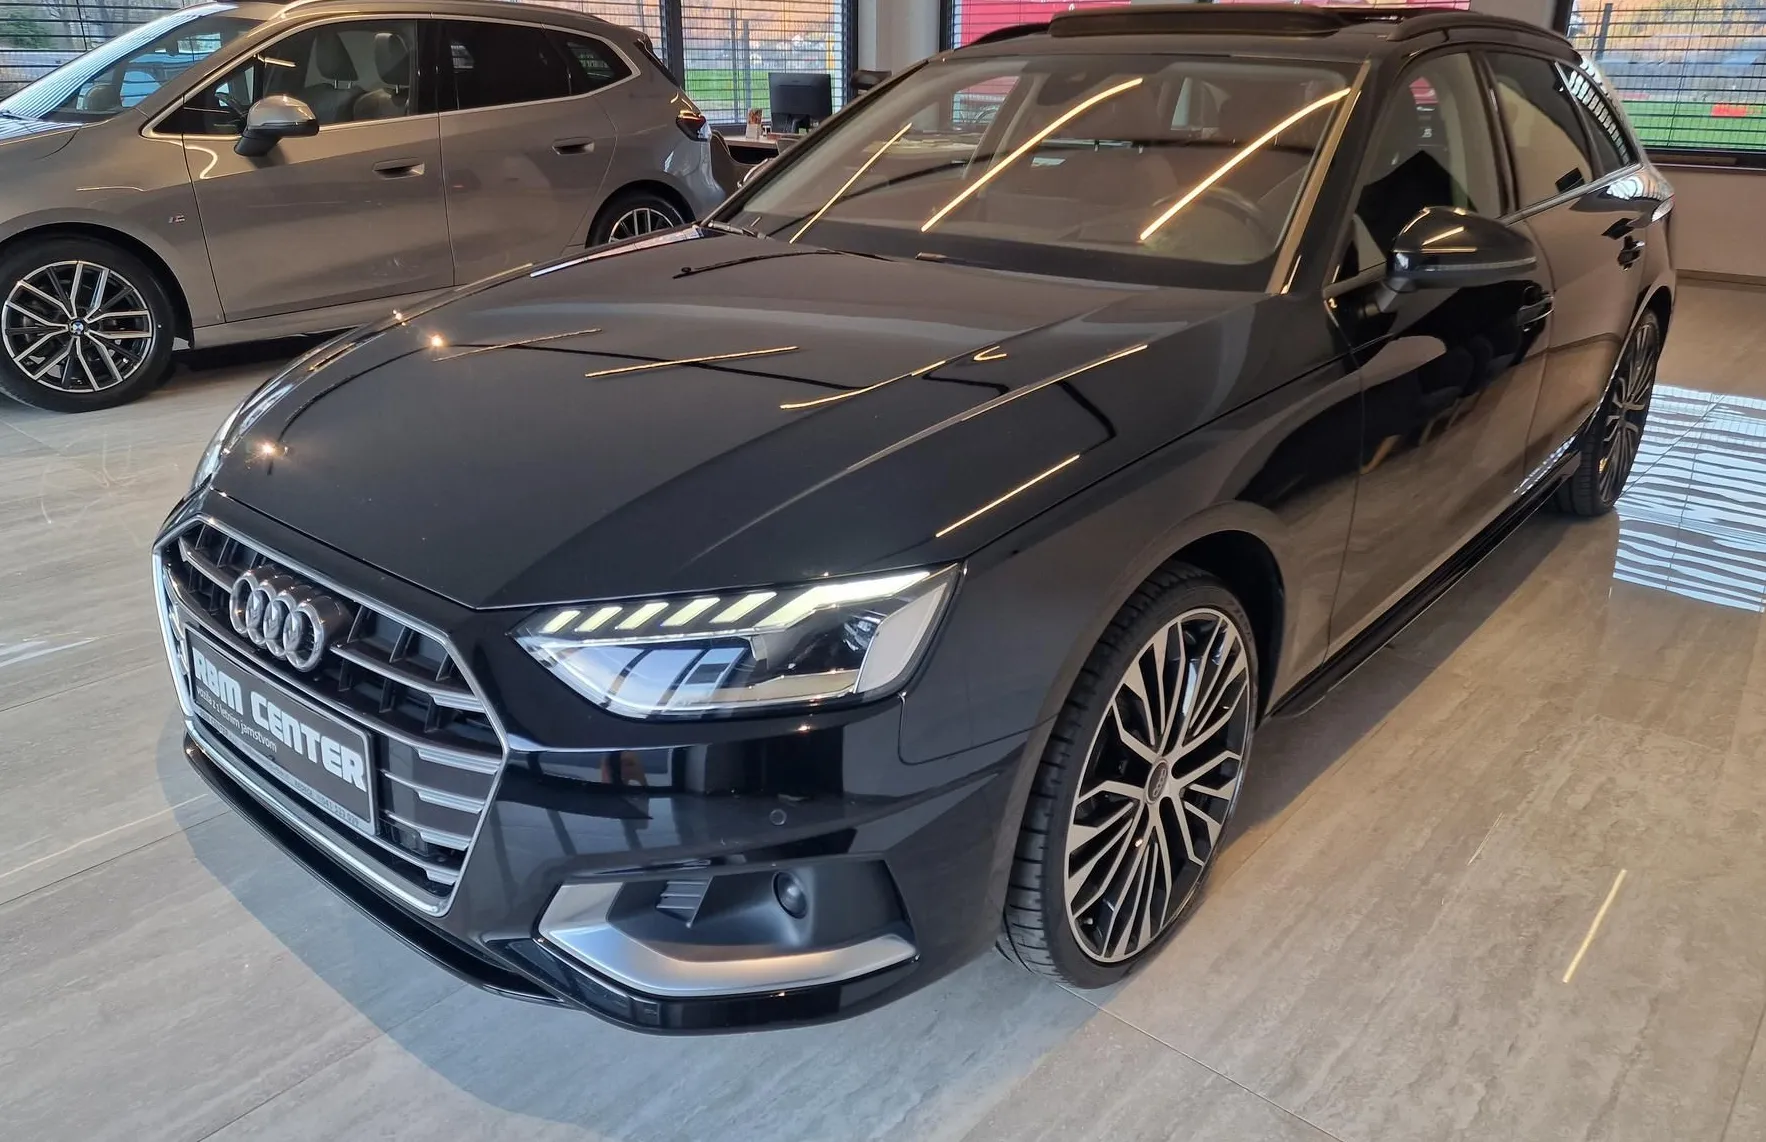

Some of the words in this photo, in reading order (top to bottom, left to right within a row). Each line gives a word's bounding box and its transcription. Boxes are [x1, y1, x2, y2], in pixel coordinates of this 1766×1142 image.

[192, 646, 244, 715] RBM
[250, 691, 367, 792] CENTER
[240, 719, 277, 753] jamstvom
